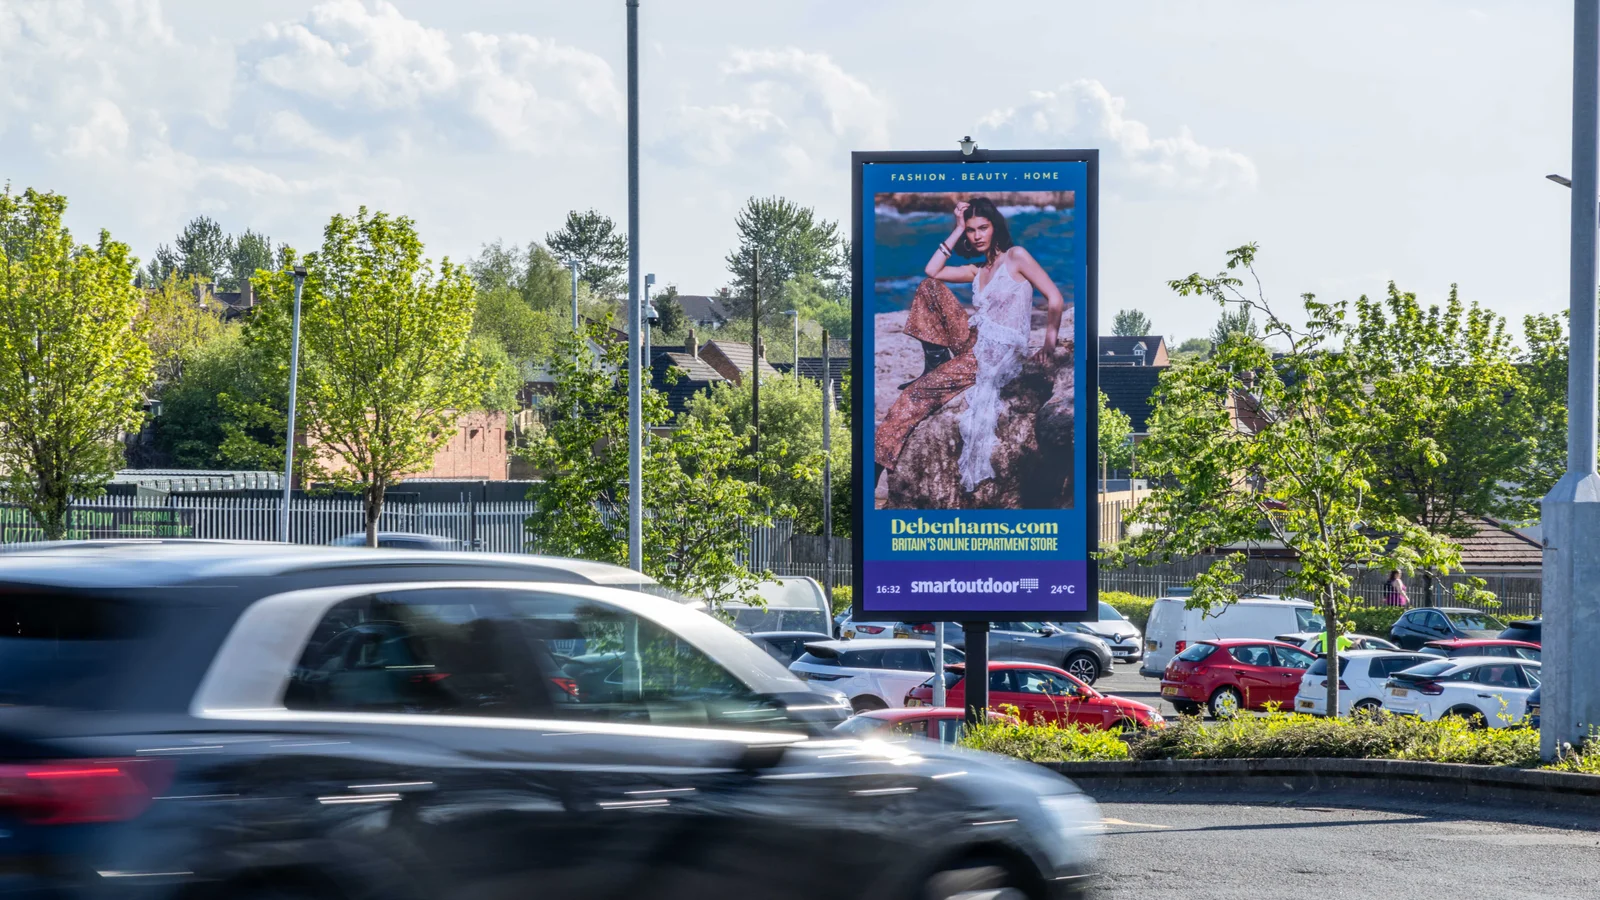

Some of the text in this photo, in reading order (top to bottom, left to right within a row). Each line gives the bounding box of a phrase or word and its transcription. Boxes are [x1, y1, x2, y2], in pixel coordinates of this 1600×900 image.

[891, 173, 946, 181] FASHION
[962, 172, 1008, 180] BEAUTY
[1024, 172, 1059, 180] HOME
[133, 511, 180, 522] PERSONAL &
[159, 525, 193, 536] STORAGE
[891, 517, 1058, 535] Debenhams.com
[892, 538, 1058, 551] BRITAIN'S ONLINE DEPARTMENT STORE
[876, 585, 901, 594] 16:32
[911, 578, 1020, 593] smartoutdoor
[1050, 585, 1075, 594] 24°C
